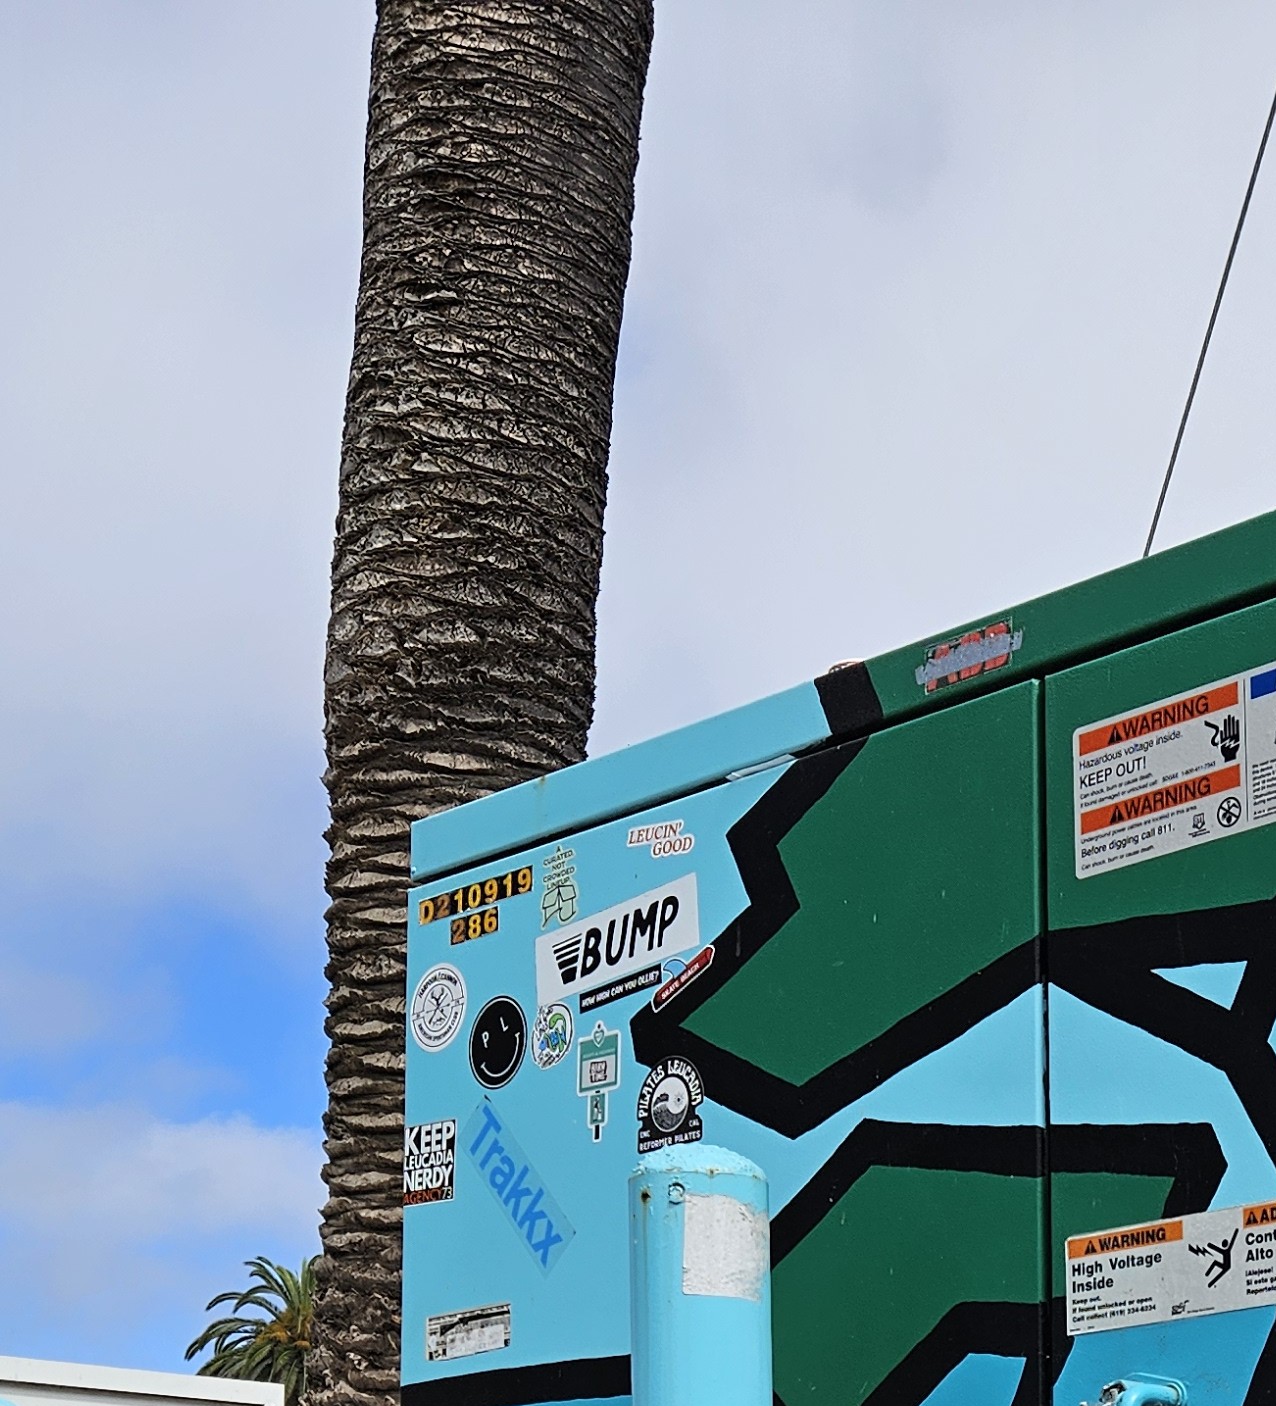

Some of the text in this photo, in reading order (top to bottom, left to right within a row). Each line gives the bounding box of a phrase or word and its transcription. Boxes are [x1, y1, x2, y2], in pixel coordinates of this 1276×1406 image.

[1122, 695, 1210, 741] WARNING
[1079, 729, 1183, 770] Hazardous voltage inside.
[1079, 756, 1147, 789] KEEP OUT!
[1126, 776, 1211, 820] WARNING
[628, 822, 682, 845] LEUCIN'
[1081, 830, 1111, 845] Underground
[1081, 823, 1175, 858] Before digging call 811.
[653, 837, 692, 856] GOOD
[552, 861, 566, 871] NOT
[452, 908, 498, 944] 286
[580, 895, 679, 978] BUMP
[611, 983, 623, 997] CAN
[624, 978, 637, 991] YOU
[661, 981, 680, 1000] SKATE
[481, 1016, 509, 1048] P L
[638, 1065, 665, 1118] PILATES
[667, 1059, 702, 1106] LEUCADIA
[404, 1121, 455, 1157] KEEP
[674, 1130, 701, 1143] PILATES
[404, 1149, 453, 1170] LEUCADIA
[403, 1164, 453, 1193] NERDY
[469, 1105, 563, 1269] Trakkx
[1098, 1227, 1166, 1252] WARNING
[1072, 1252, 1162, 1278] High Voltage
[1245, 1247, 1274, 1263] Alto
[1072, 1276, 1114, 1293] Inside
[1246, 1278, 1252, 1286] Si
[1254, 1276, 1268, 1285] este
[1072, 1298, 1088, 1306] Keep
[1078, 1304, 1096, 1313] found
[1097, 1301, 1126, 1311] unlocked
[1136, 1296, 1153, 1306] open
[1072, 1315, 1085, 1323] Call
[1086, 1312, 1108, 1321] collect
